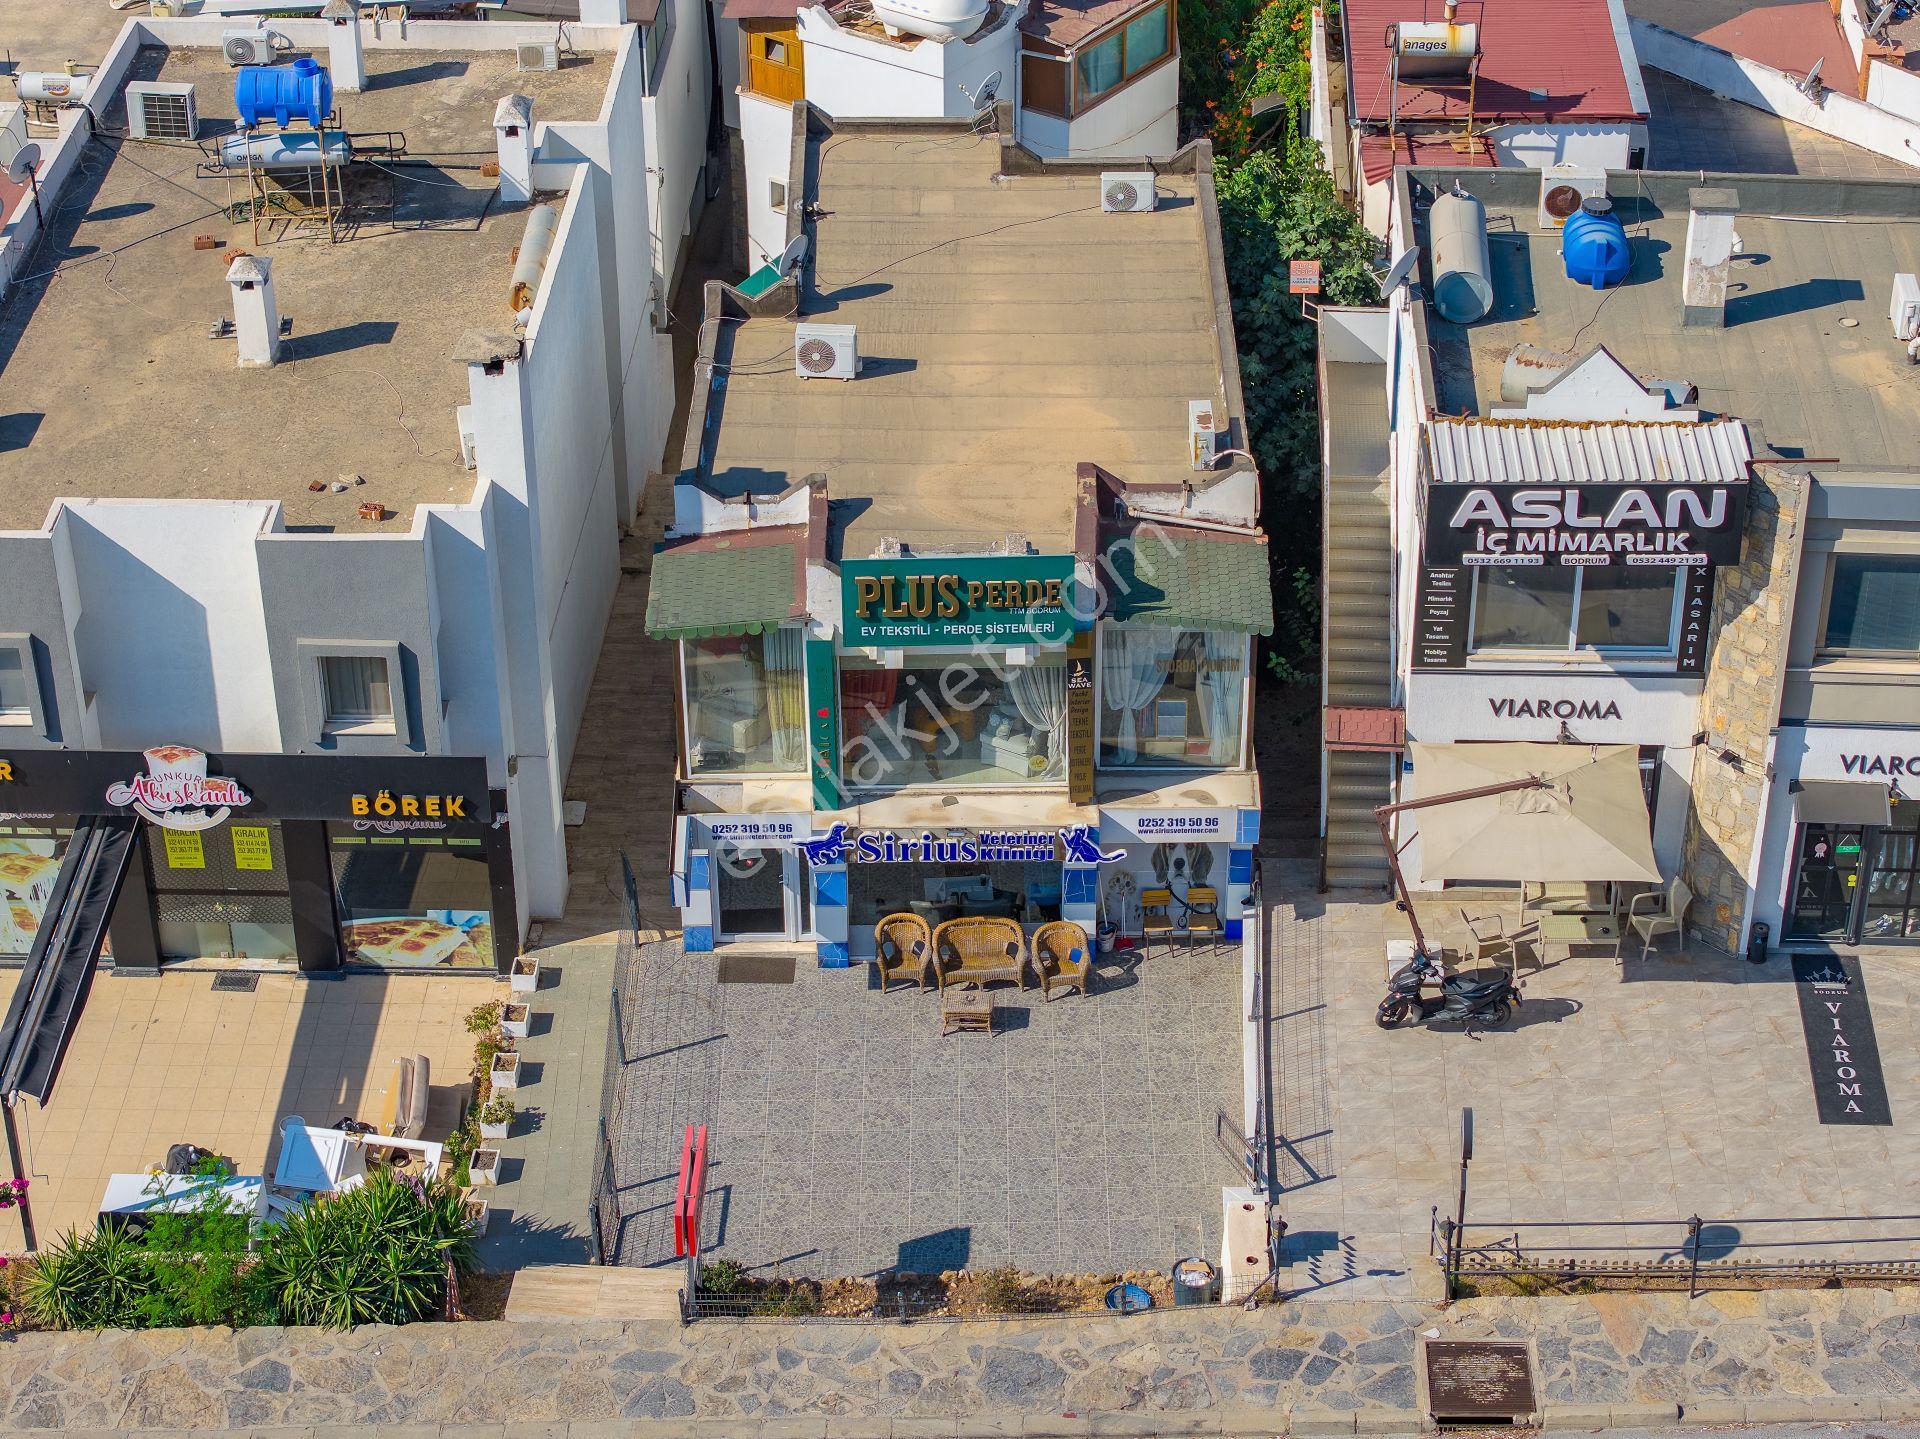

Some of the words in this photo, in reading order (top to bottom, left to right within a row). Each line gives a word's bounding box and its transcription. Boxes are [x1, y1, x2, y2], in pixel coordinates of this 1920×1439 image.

[1450, 489, 1728, 528] ASLAN
[1476, 527, 1509, 554] İÇ
[1515, 528, 1691, 552] MİMARLIK
[1467, 557, 1492, 565] 0532
[1515, 557, 1522, 565] 11
[1525, 557, 1540, 565] 93
[1564, 557, 1608, 566] BODRUM
[1632, 556, 1656, 565] 0532
[1658, 556, 1676, 565] 449
[1678, 556, 1690, 565] 21
[1691, 556, 1705, 565] 93
[855, 575, 960, 617] PLUS
[967, 579, 1063, 608] PERDE
[1026, 606, 1061, 615] BODRUM
[861, 626, 876, 636] EV
[881, 624, 931, 636] TEKSTİLİ
[943, 624, 983, 635] PERDE
[988, 621, 1055, 634] SİSTEMLERİ
[1682, 585, 1704, 667] TASARIM
[1068, 681, 1092, 689] WAVE
[1488, 698, 1622, 720] VIAROMA
[351, 789, 466, 817] BÖREK
[711, 824, 739, 833] 0252
[741, 824, 760, 833] 319
[762, 824, 776, 832] 50
[778, 823, 793, 832] 96
[1138, 818, 1165, 828] 0252
[1167, 818, 1186, 827] 319
[1188, 817, 1203, 827] 50
[1205, 817, 1219, 827] 96
[979, 830, 1055, 845] Veteriner
[857, 831, 977, 863] Sirius
[1823, 1002, 1864, 1113] VIAROMA
